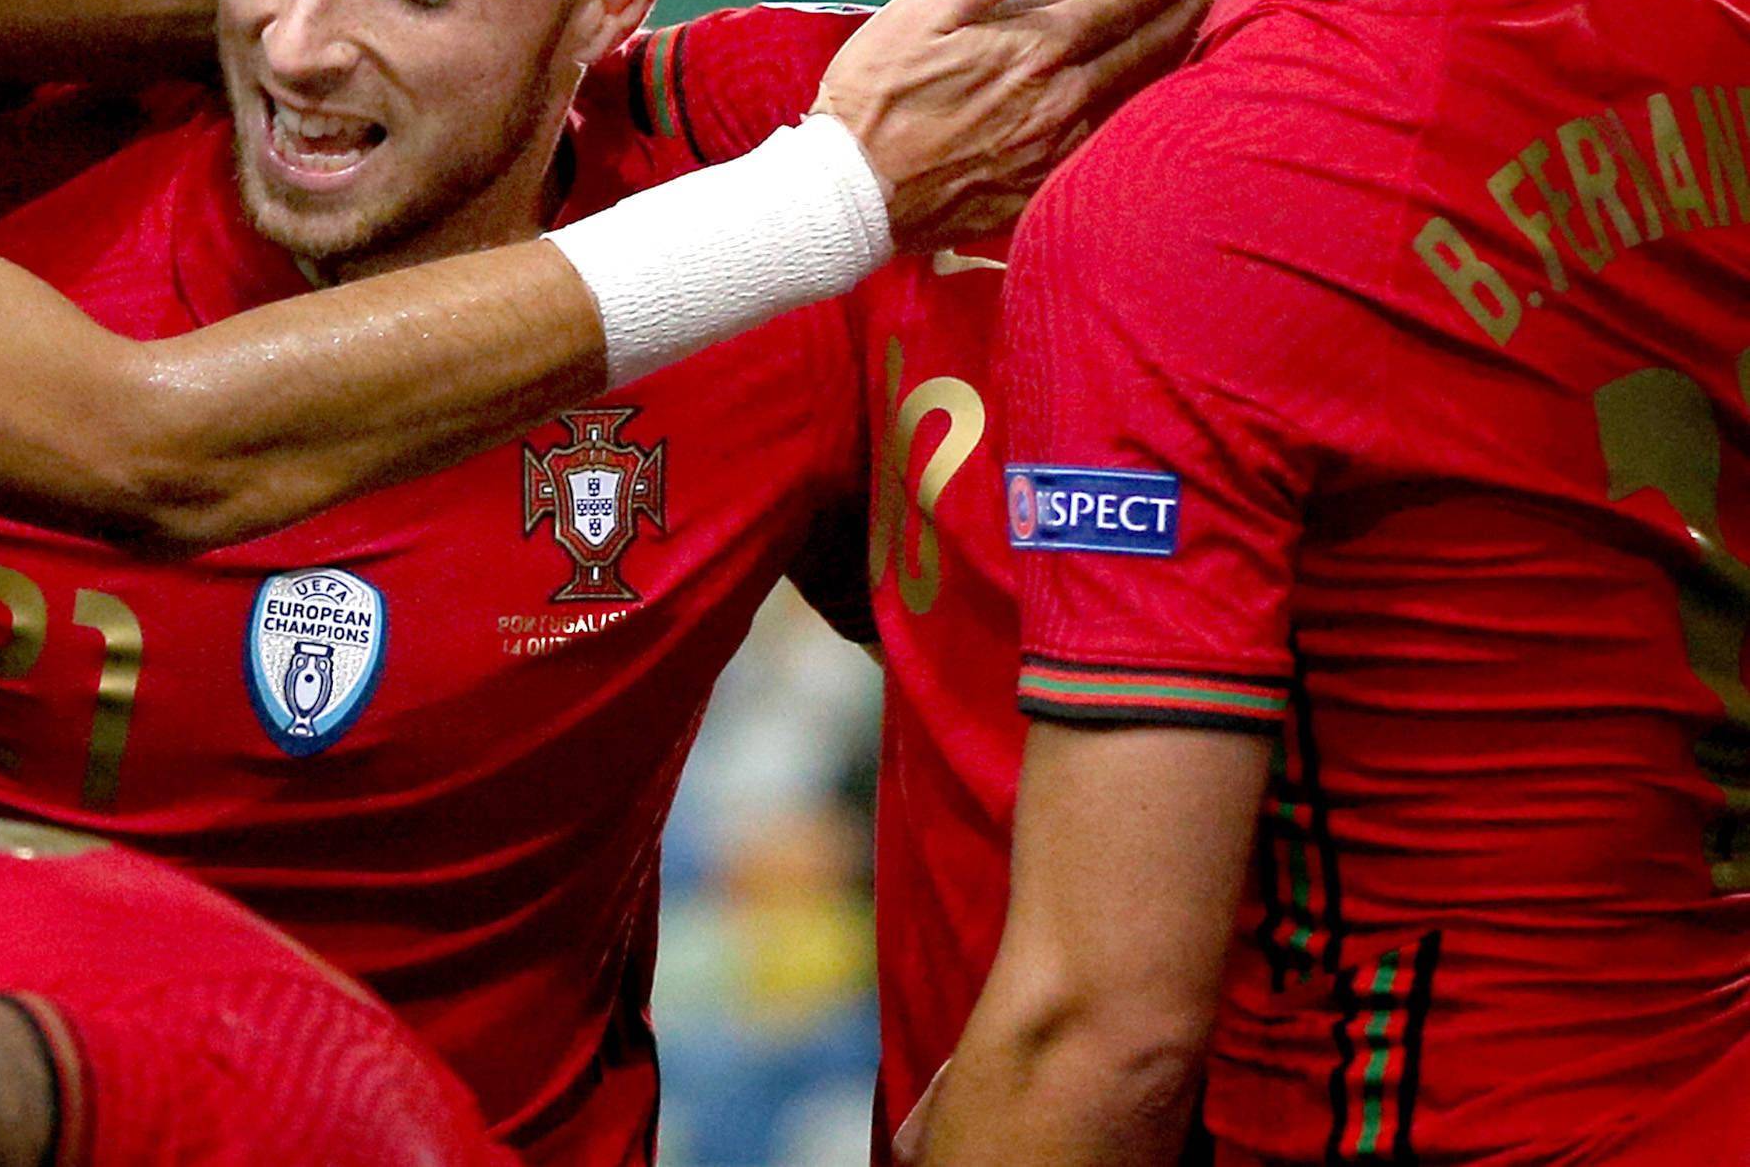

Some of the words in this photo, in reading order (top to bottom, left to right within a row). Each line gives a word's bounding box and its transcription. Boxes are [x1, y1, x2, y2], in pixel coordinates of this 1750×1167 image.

[295, 579, 348, 603] UEFA
[266, 599, 373, 628] EUROPEAN
[263, 617, 370, 644] CHAMPIONS
